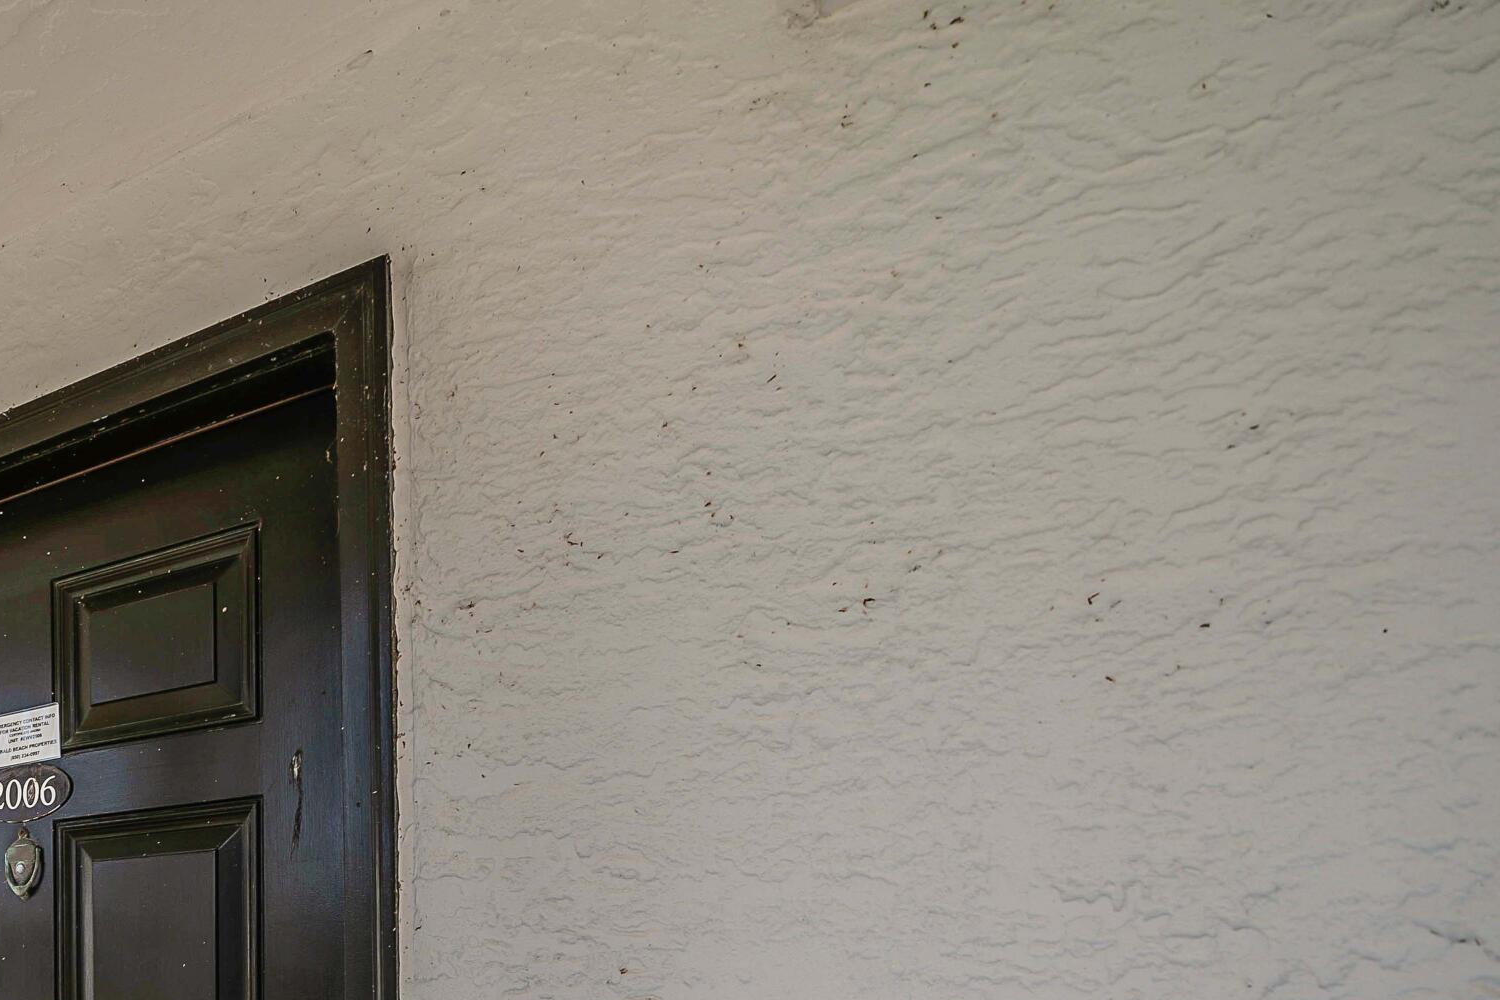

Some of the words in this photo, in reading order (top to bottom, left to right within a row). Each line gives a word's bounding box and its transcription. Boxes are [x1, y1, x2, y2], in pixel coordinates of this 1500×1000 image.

[22, 715, 44, 725] CONTACT
[44, 712, 56, 720] INFO
[9, 725, 31, 733] VACATION
[28, 739, 57, 749] PROPERTIES
